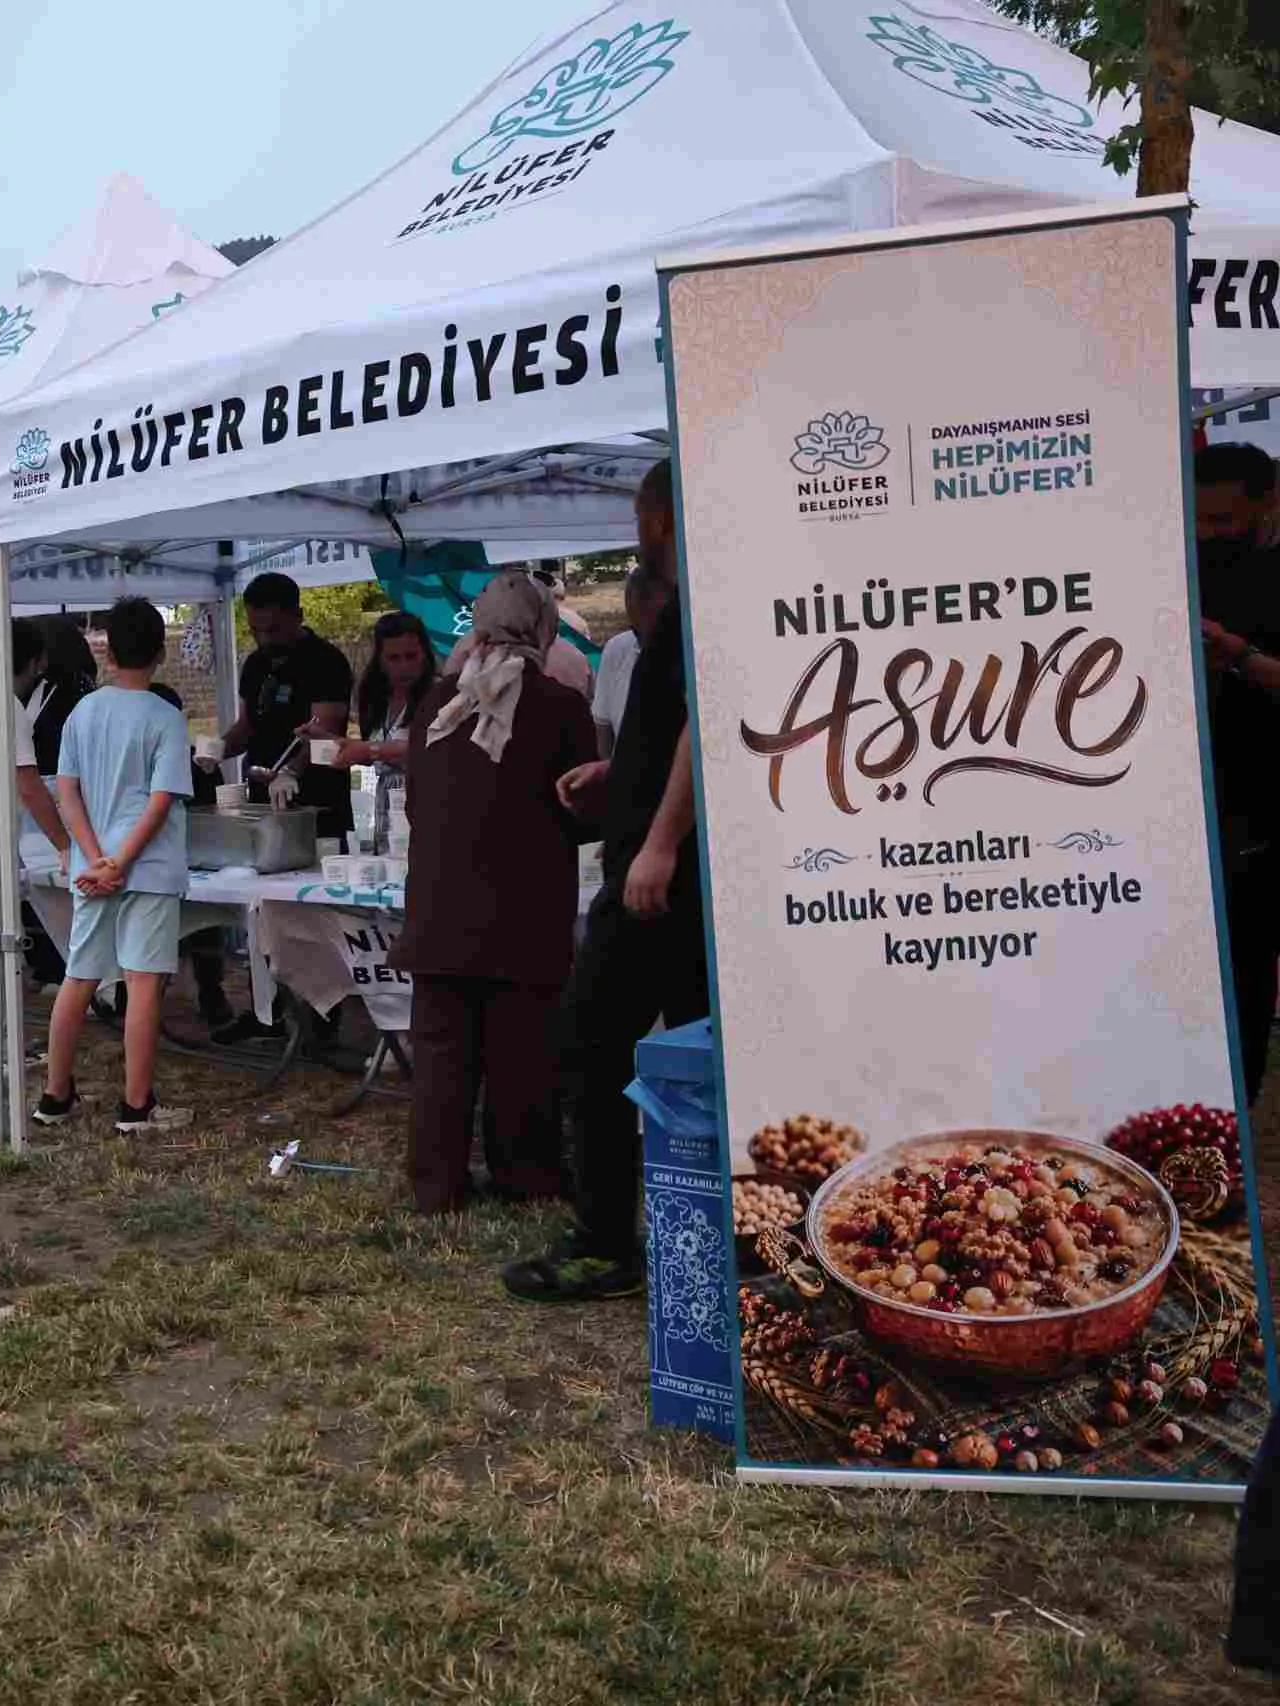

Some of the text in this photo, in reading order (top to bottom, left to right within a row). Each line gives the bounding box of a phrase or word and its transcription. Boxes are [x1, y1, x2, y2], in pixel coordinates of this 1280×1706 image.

[422, 128, 616, 212] NİLÜFER
[397, 158, 591, 238] BELEDİYESİ
[1187, 258, 1280, 328] FER
[60, 283, 623, 489] NİLÜFER BELEDİYESİ
[931, 409, 1090, 440] DAYANIŞMANIN SESİ
[933, 432, 1091, 470] HEPİMİZİN
[798, 476, 888, 496] NİLÜFER
[799, 492, 888, 512] BELEDİYESİ
[773, 572, 1093, 636] NİLÜFER'DE
[880, 830, 1031, 868] kazanları
[785, 872, 1143, 925] bolluk ve bereketiyle
[885, 929, 1037, 970] kaynıyor
[352, 964, 411, 984] BEL
